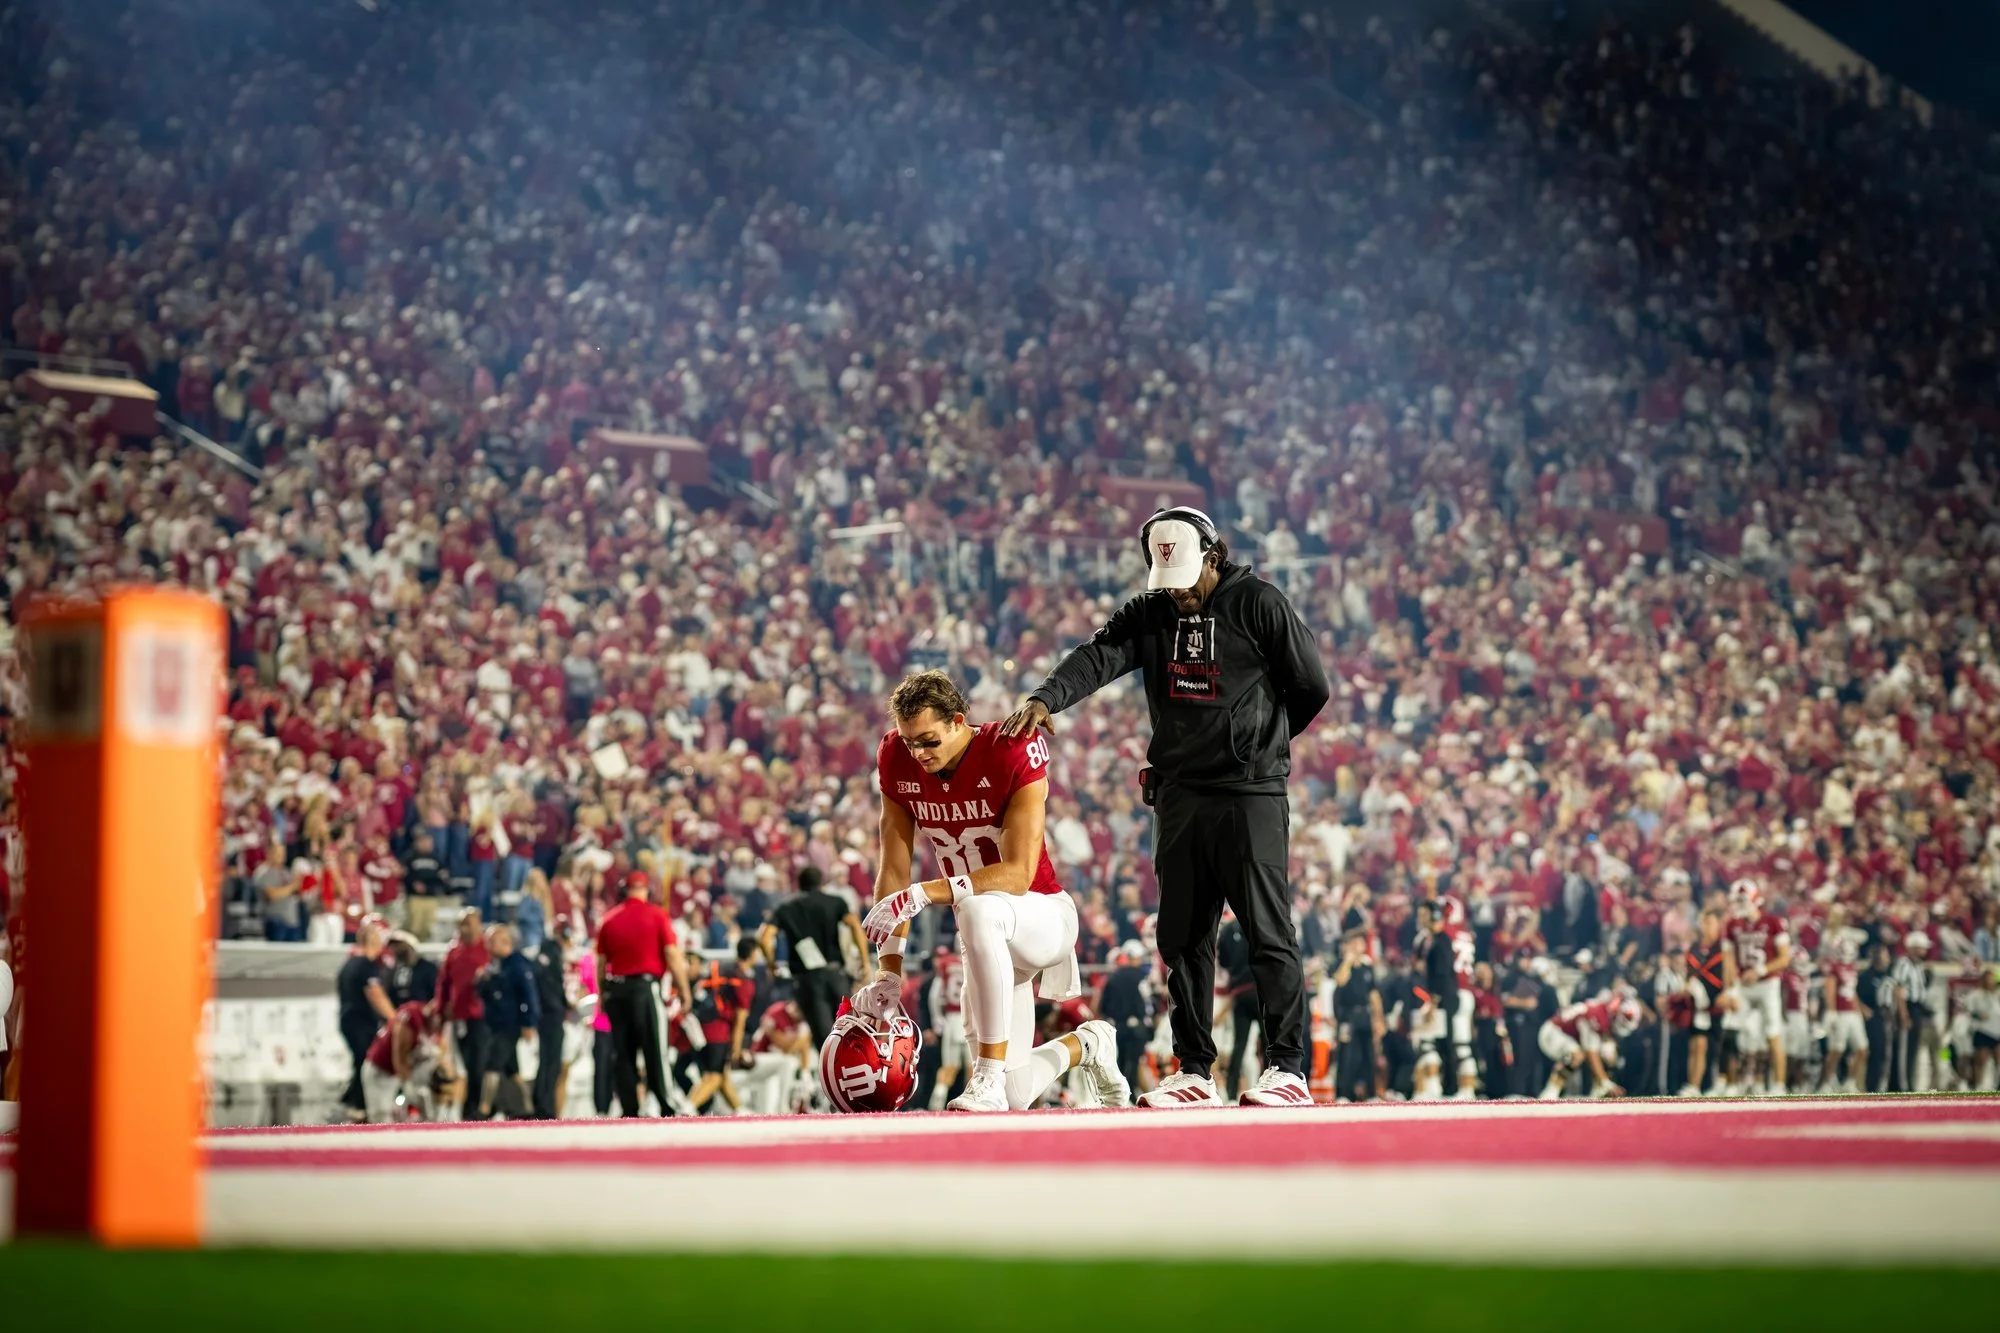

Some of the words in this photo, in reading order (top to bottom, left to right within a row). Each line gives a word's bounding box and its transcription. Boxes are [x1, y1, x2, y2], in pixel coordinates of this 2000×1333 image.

[1167, 663, 1221, 676] FOOTBALL
[1026, 735, 1050, 769] 80
[909, 799, 995, 821] INDIANA
[920, 825, 1004, 879] 80
